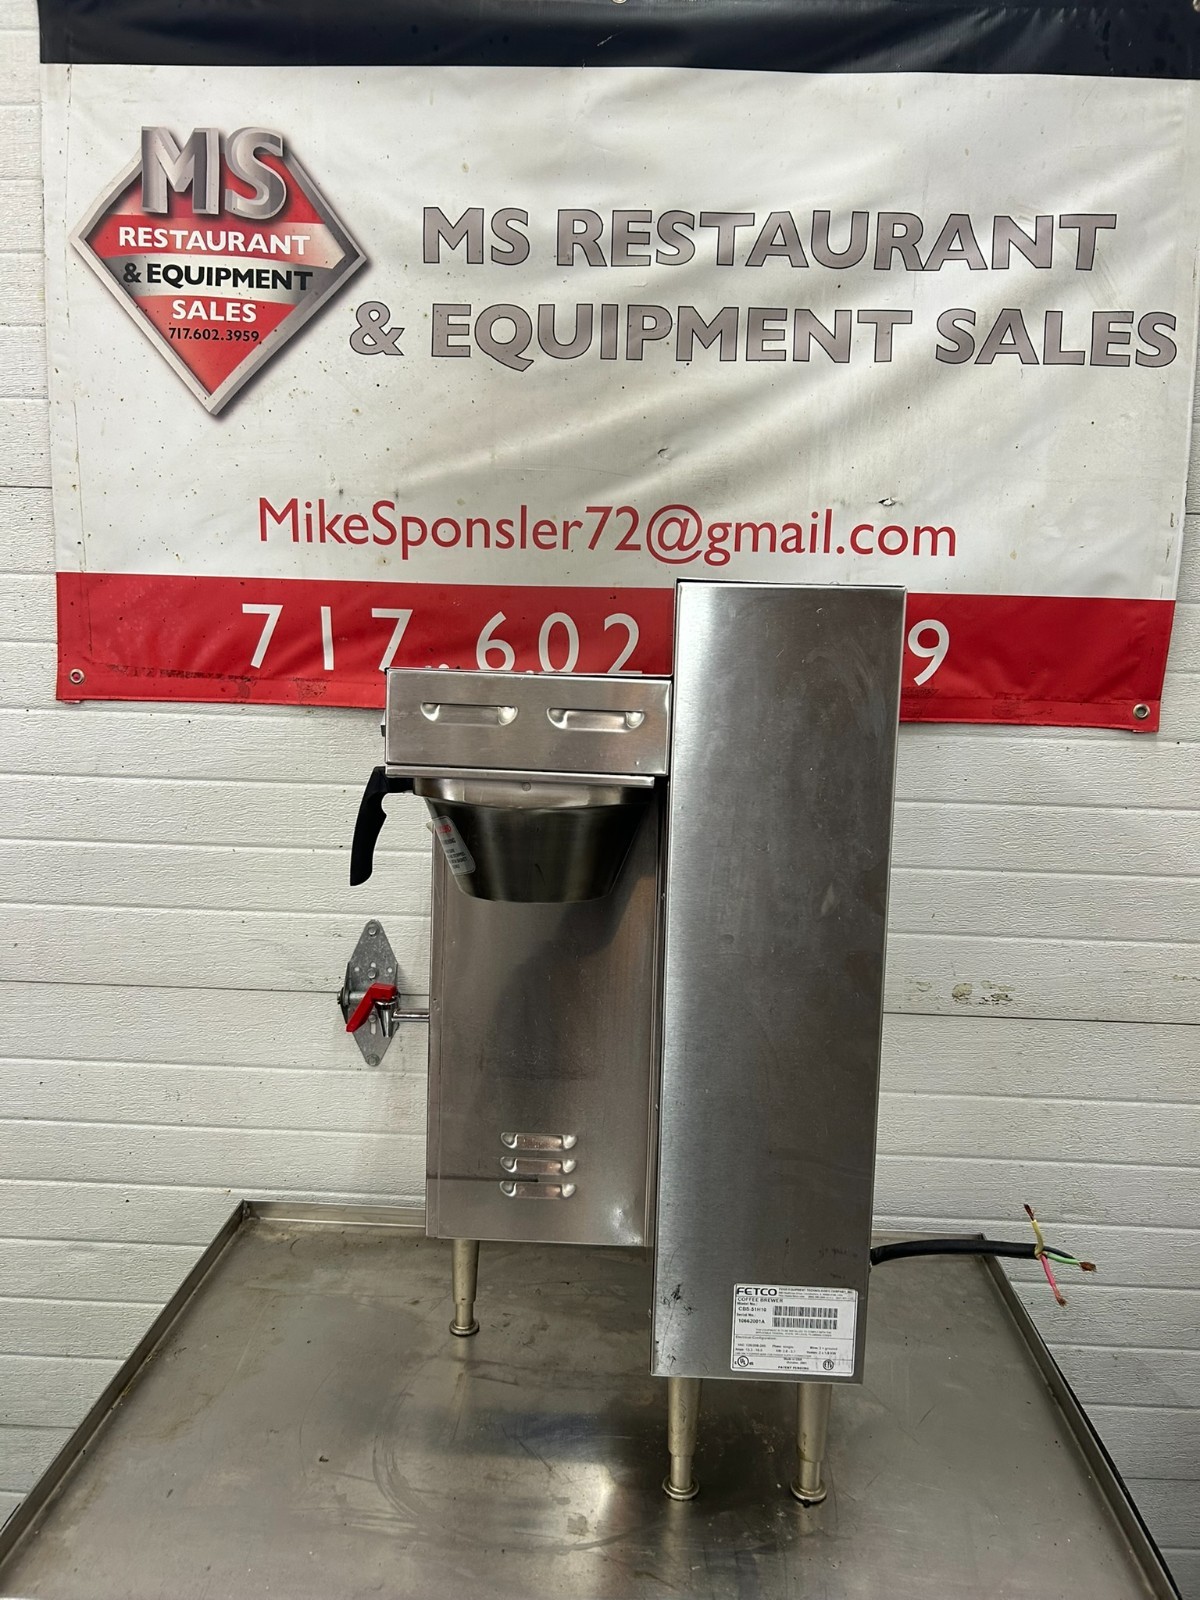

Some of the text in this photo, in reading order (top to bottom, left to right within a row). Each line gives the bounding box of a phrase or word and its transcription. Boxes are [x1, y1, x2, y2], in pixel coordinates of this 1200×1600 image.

[141, 126, 288, 220] MS
[118, 226, 311, 256] RESTAURANT
[422, 206, 1117, 271] MS RESTAURANT
[122, 262, 314, 292] & EQUIPMENT
[171, 299, 258, 323] SALES
[168, 327, 260, 343] 717.602.3959
[349, 300, 1178, 373] & EQUIPMENT SALES
[258, 497, 957, 566] MikeSponsler72@gmail.com
[736, 1287, 777, 1297] FETCO
